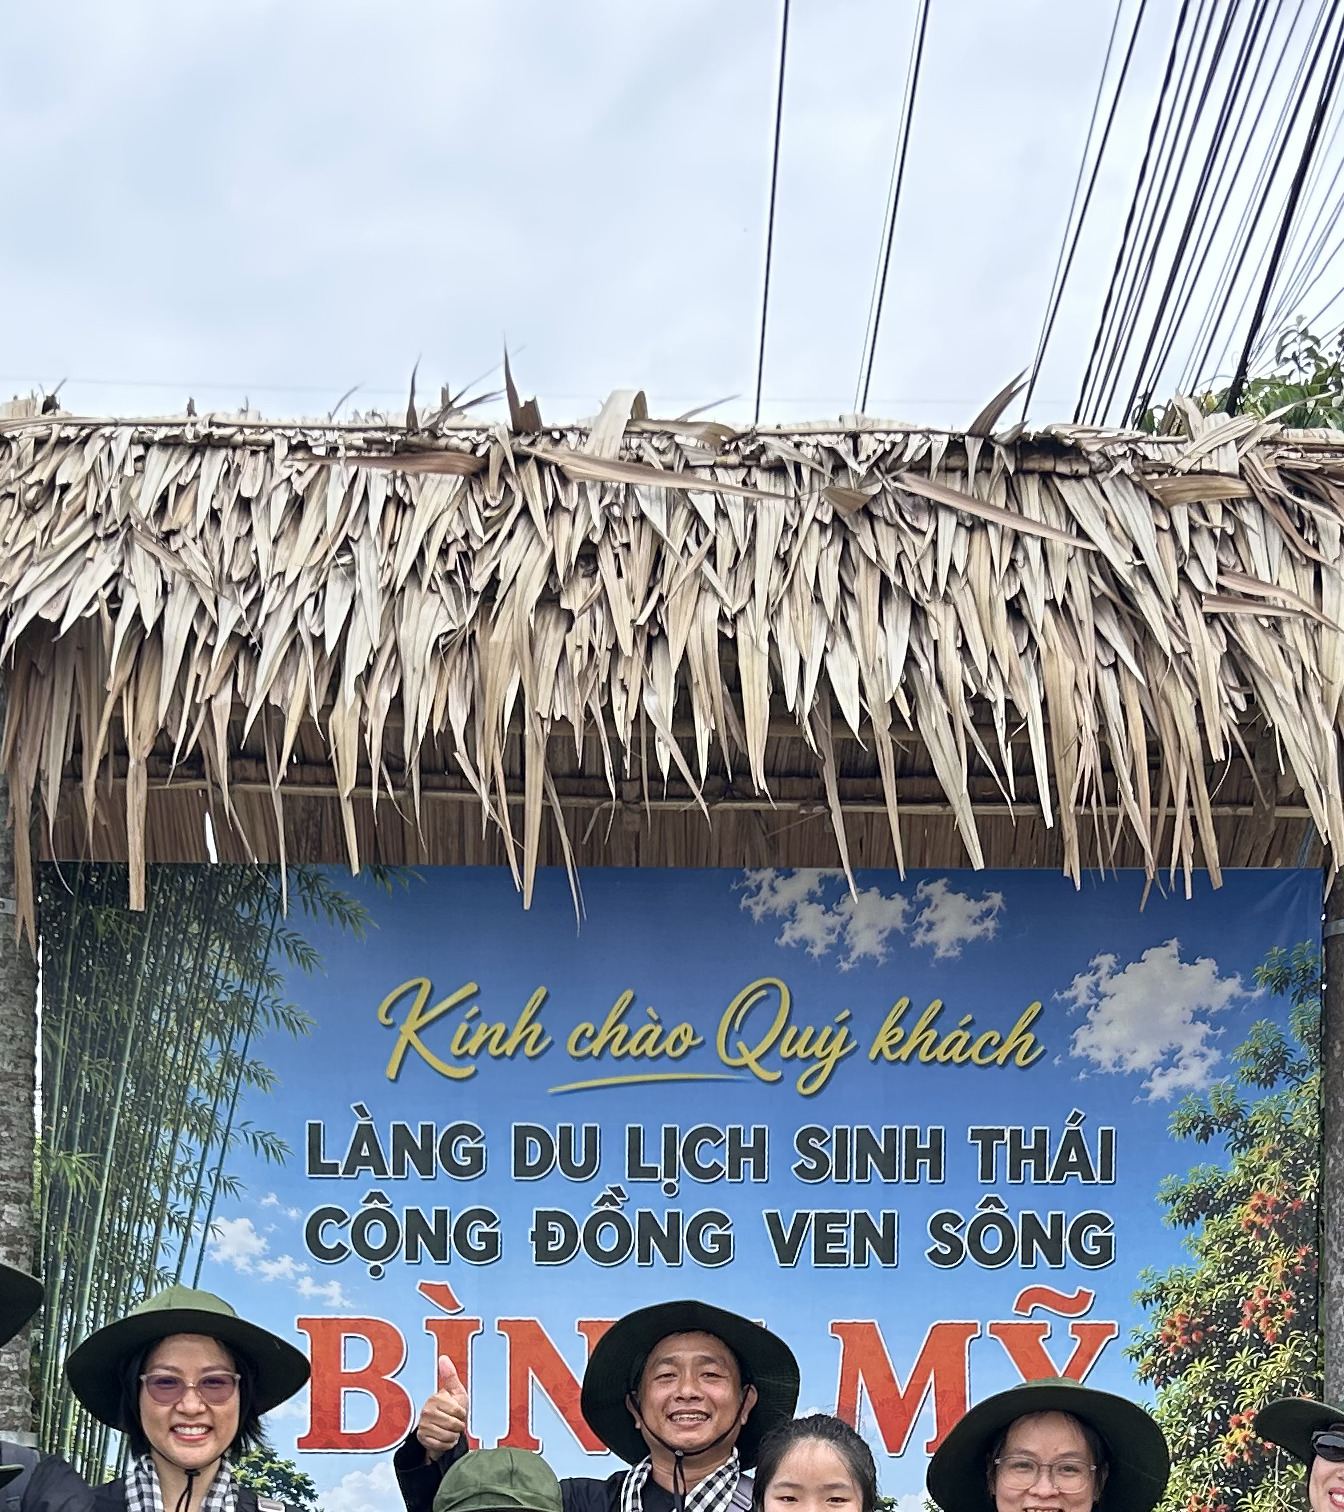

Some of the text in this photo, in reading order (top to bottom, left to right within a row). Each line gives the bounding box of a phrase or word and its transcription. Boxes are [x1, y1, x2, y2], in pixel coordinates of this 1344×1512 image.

[378, 977, 1047, 1097] Kính chào Quý khách
[305, 1102, 1117, 1197] LÀNG DU LỊCH SINH THÁI
[304, 1183, 1116, 1279] CỘNG ĐỒNG VEN SÔNG
[296, 1280, 1120, 1457] BÌN MỸ
